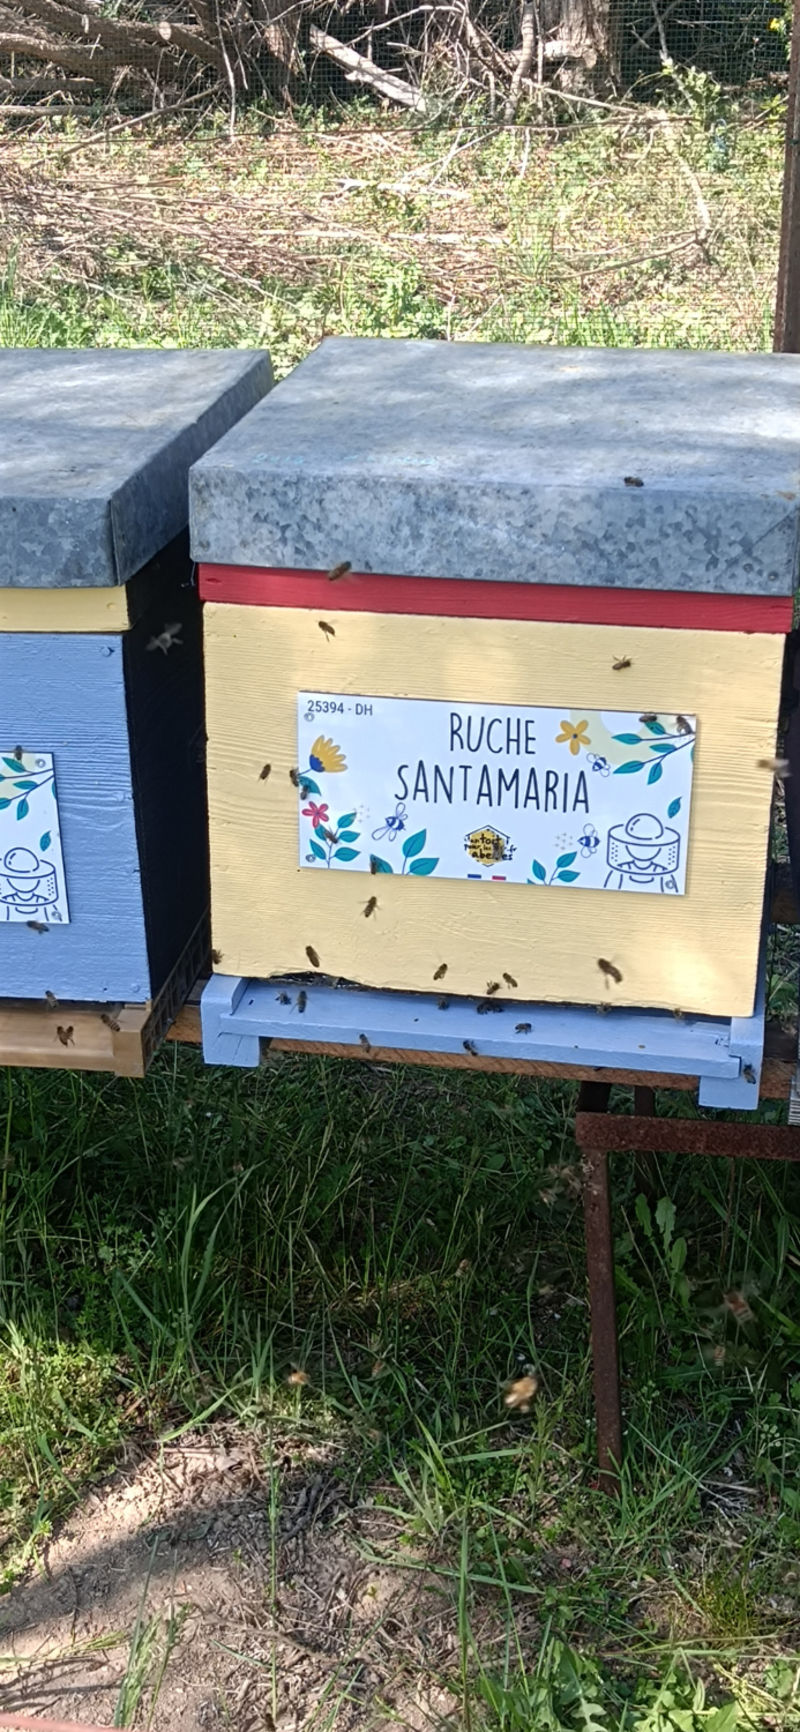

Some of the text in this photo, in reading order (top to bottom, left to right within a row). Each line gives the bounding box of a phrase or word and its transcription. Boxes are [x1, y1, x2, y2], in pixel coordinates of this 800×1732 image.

[307, 699, 344, 714] 25394
[355, 703, 373, 716] DH
[449, 712, 537, 755] RUCHE
[394, 760, 590, 814] SANTAMARIA
[472, 848, 513, 861] abees
